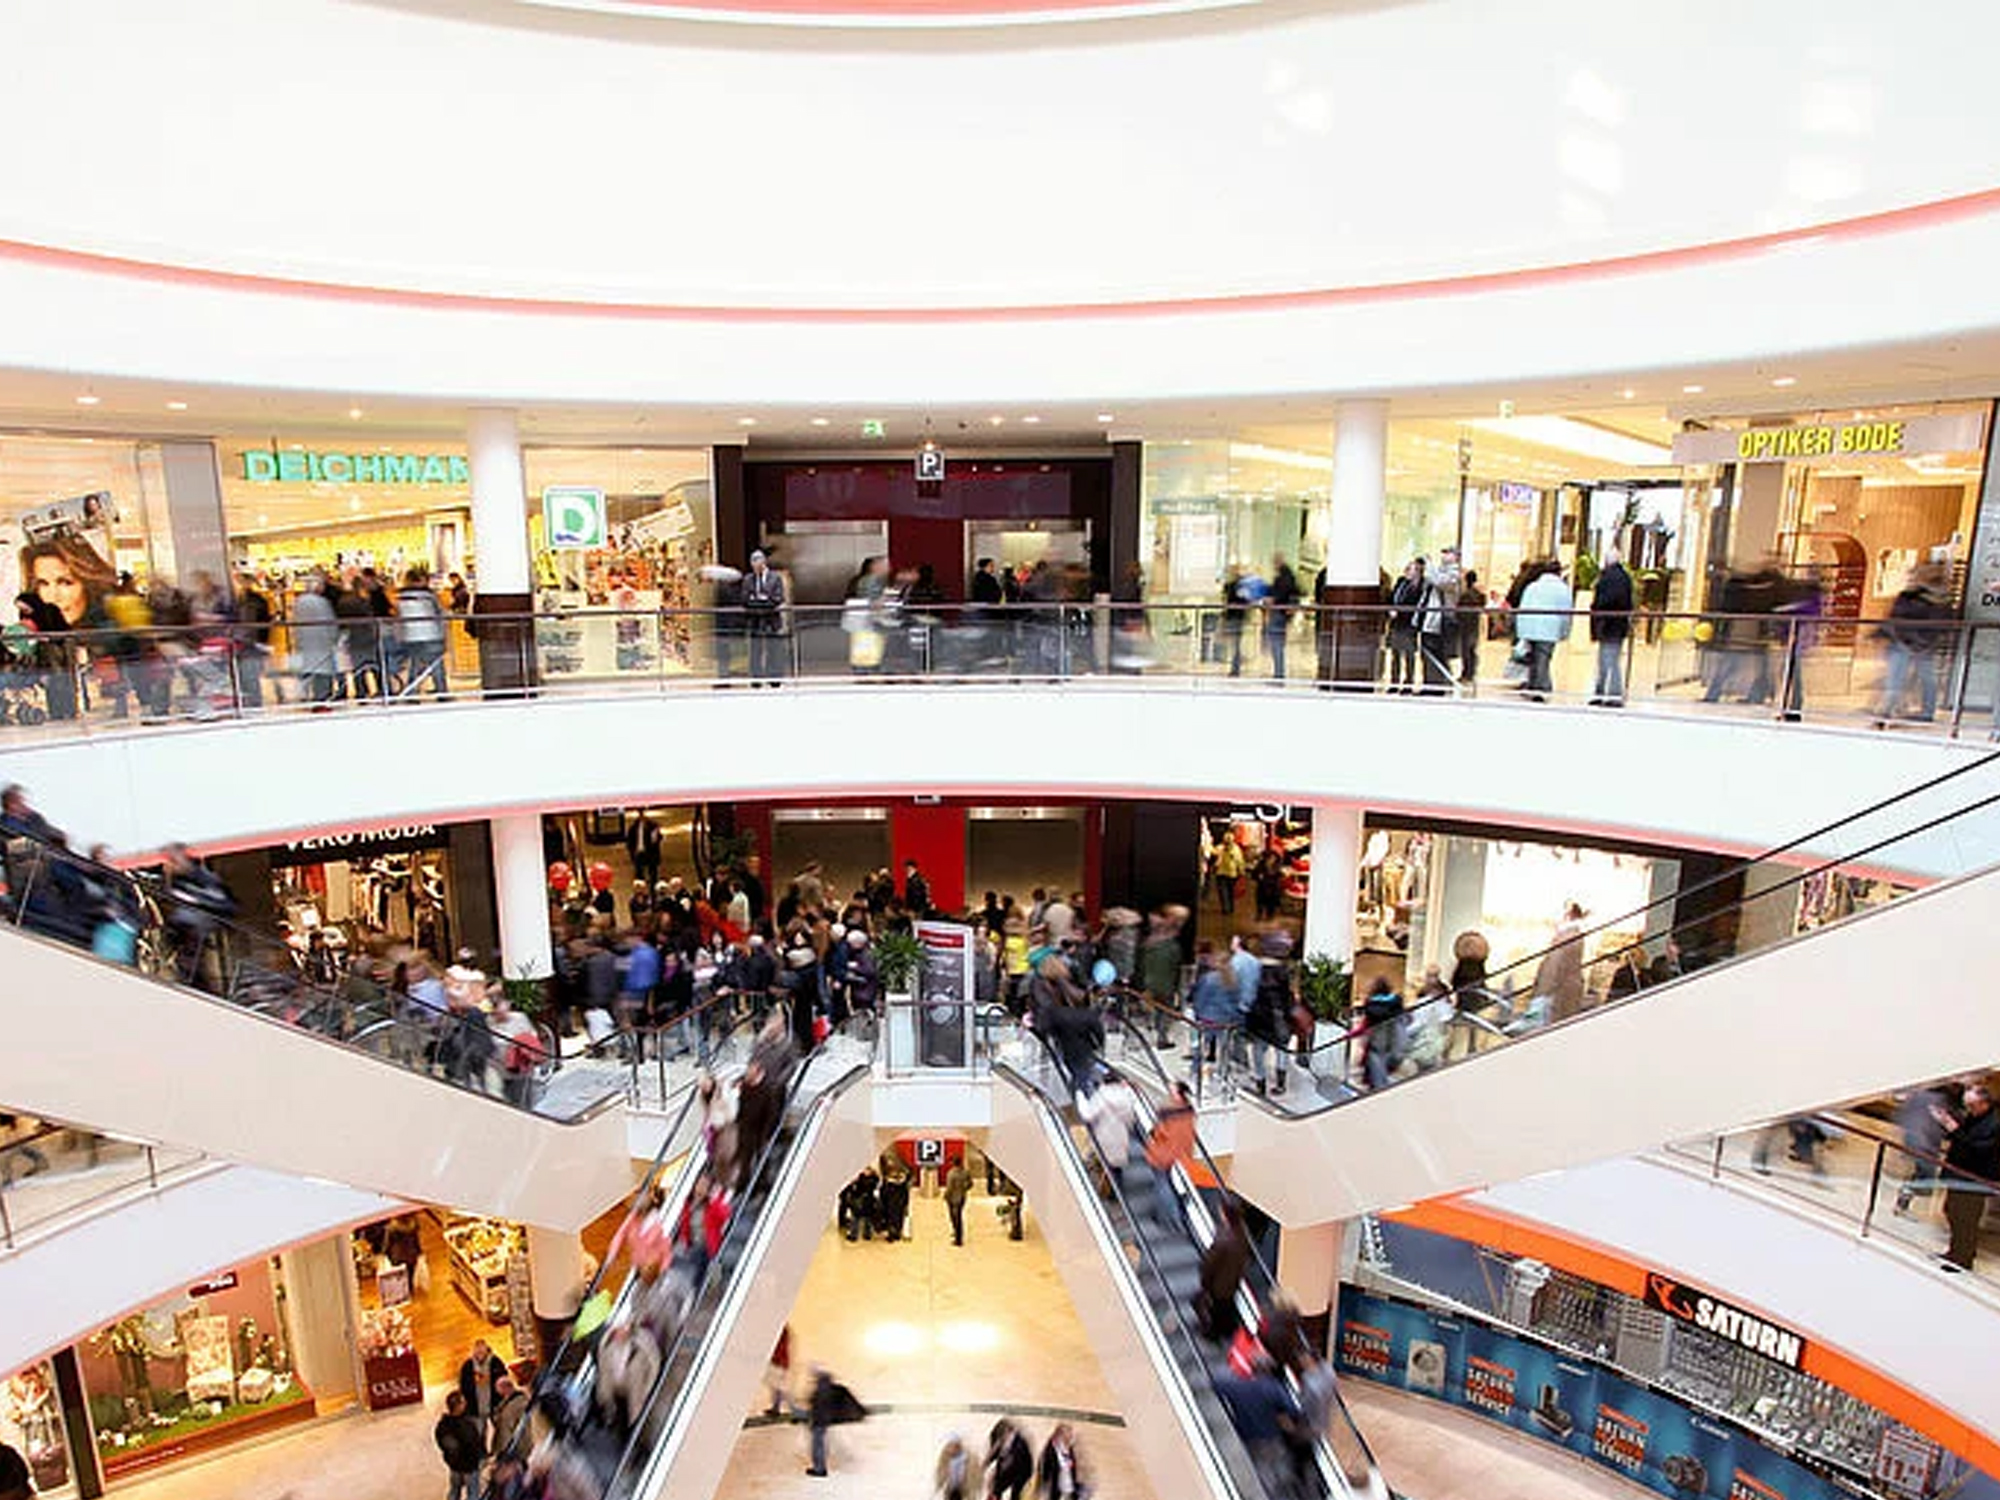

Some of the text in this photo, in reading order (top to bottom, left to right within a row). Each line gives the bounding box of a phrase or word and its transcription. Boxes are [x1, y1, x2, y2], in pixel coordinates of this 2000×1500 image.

[1739, 427, 1832, 458] OPTIKER
[922, 452, 938, 475] P
[922, 1139, 938, 1159] P
[1695, 1298, 1801, 1367] SATURN
